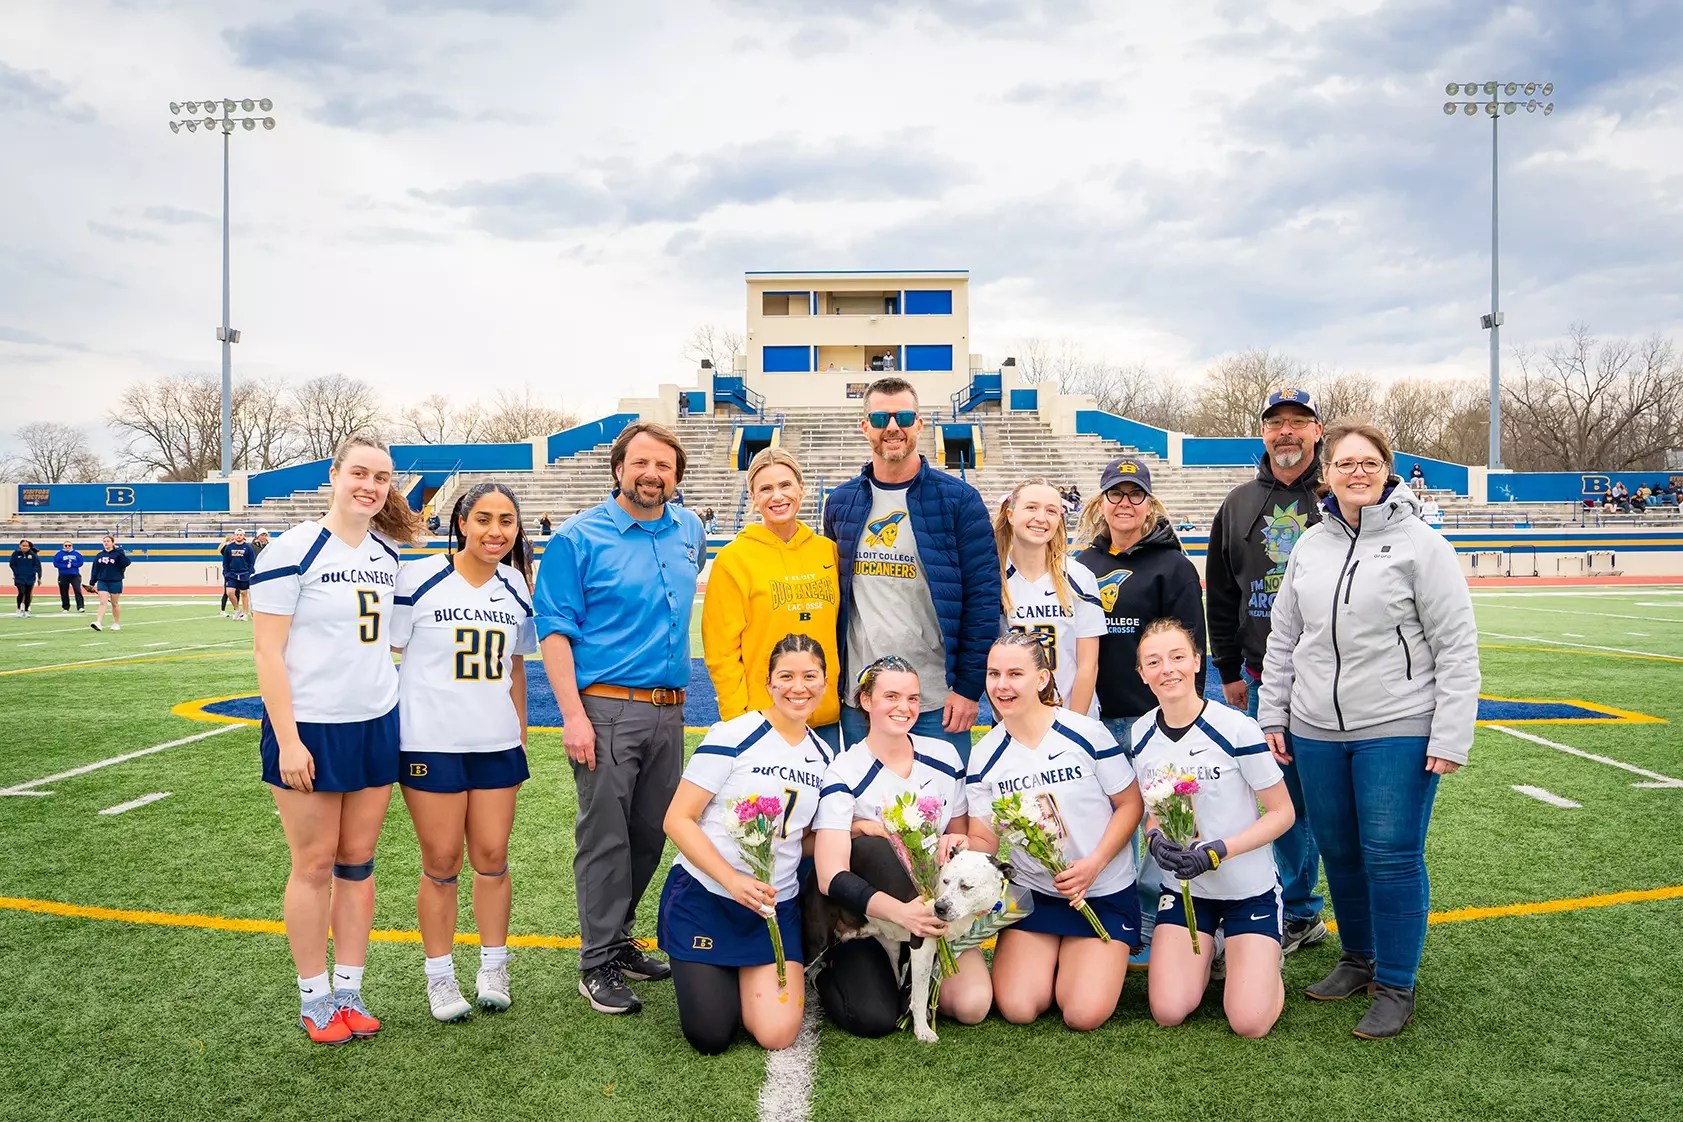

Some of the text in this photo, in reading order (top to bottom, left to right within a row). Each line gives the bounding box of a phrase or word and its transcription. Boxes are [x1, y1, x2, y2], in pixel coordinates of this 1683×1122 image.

[1120, 463, 1137, 474] B
[1582, 476, 1611, 494] B
[106, 486, 135, 506] B
[878, 552, 915, 562] COLLEGE
[321, 569, 394, 587] BUCCANEERS
[852, 561, 917, 579] UCCANEERS
[1265, 577, 1283, 591] NO
[769, 576, 835, 610] BUCANEERS
[787, 601, 823, 611] LACOSSE
[356, 589, 380, 644] 5
[434, 608, 517, 625] BUCCANEERS
[799, 612, 812, 621] B
[1105, 617, 1140, 626] OLLEGE
[454, 627, 506, 682] 20
[410, 763, 427, 776] B
[998, 766, 1082, 795] BUCCANEERS
[1158, 894, 1176, 911] B
[693, 936, 713, 949] B
